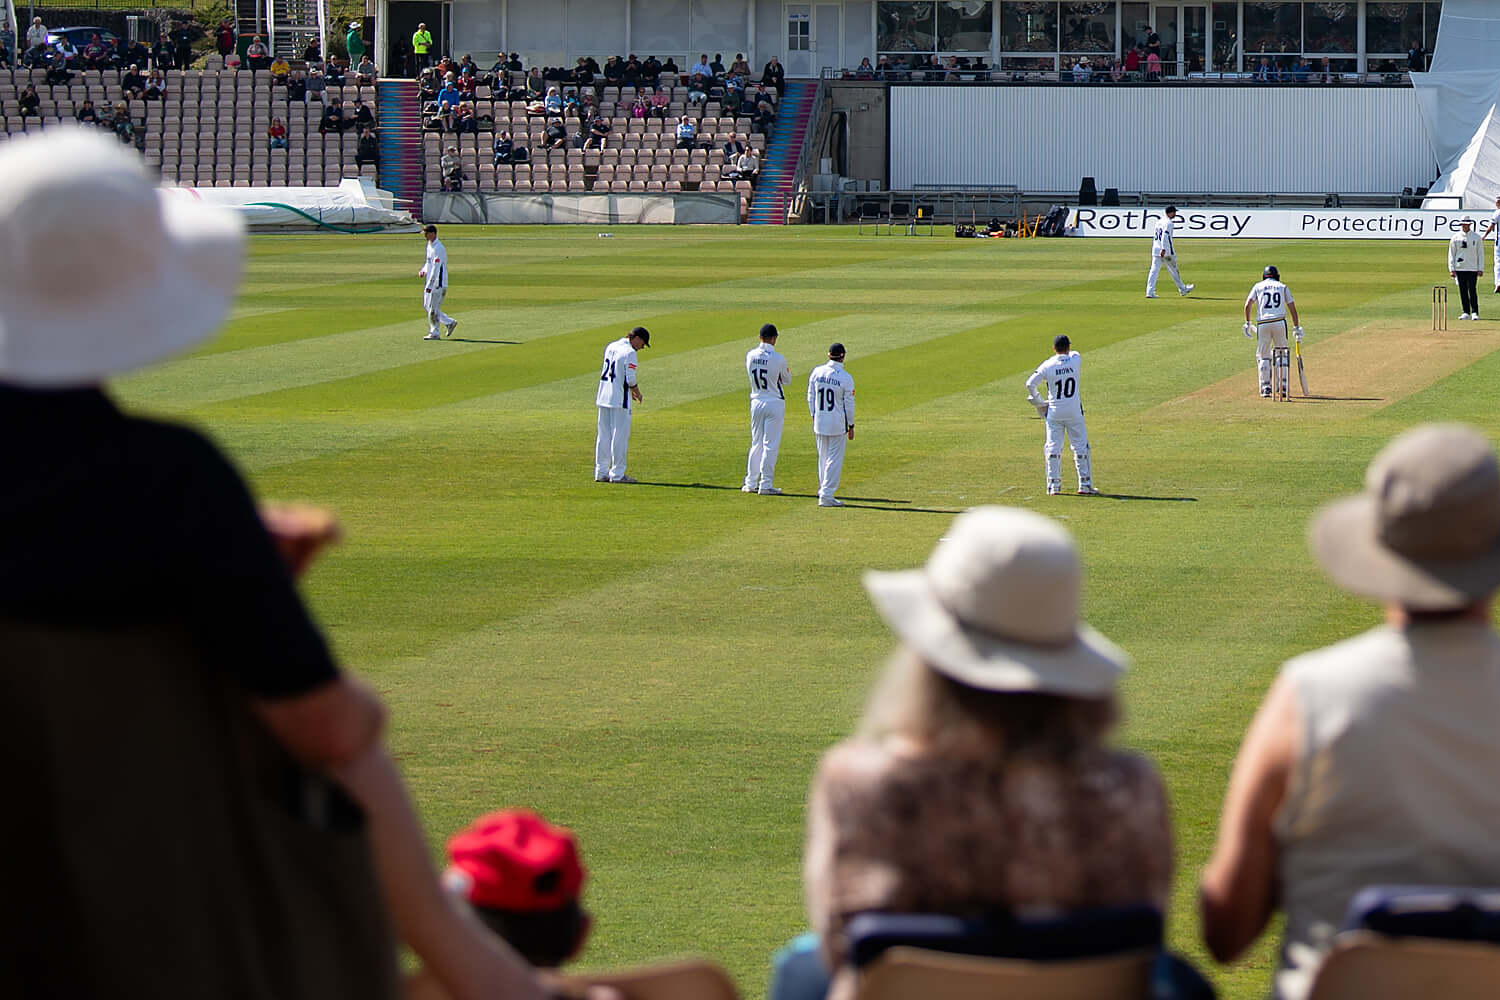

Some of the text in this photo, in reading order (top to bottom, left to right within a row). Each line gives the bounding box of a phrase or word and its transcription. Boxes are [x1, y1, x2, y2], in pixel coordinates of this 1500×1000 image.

[1076, 209, 1252, 236] Rothesay
[1302, 214, 1424, 237] Protecting
[1263, 292, 1281, 309] 29
[601, 358, 616, 383] 24
[752, 368, 768, 390] 15
[818, 387, 835, 412] 19
[1055, 377, 1076, 400] 10
